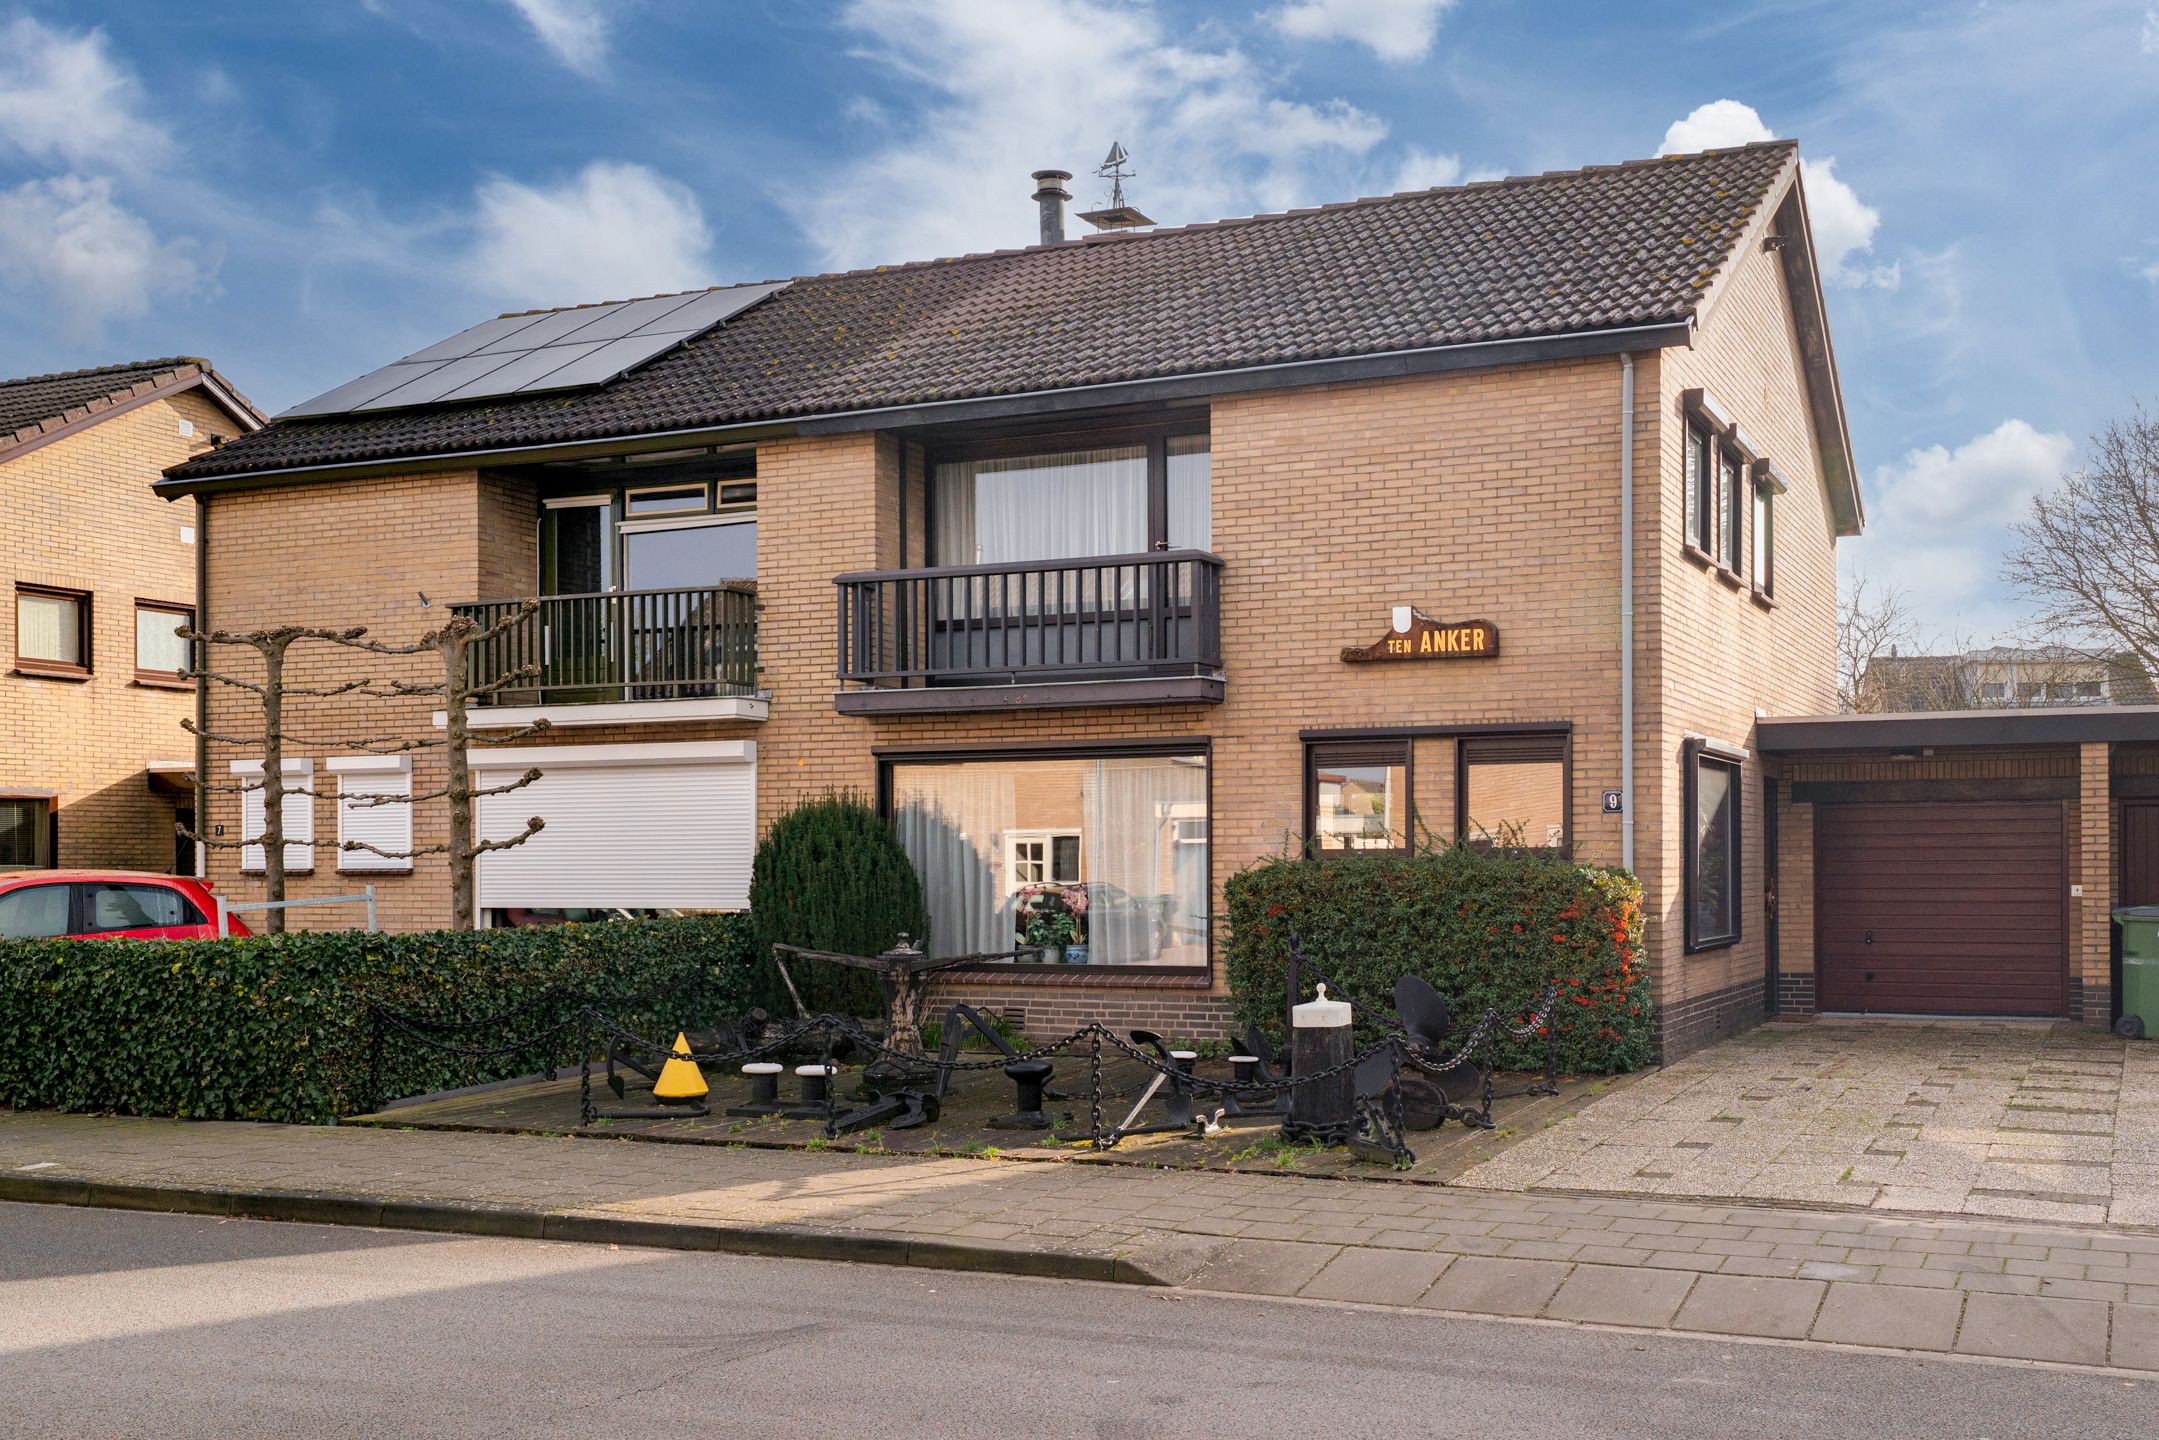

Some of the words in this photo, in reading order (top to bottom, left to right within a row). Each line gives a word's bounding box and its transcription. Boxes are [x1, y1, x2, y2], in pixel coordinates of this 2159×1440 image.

[1388, 640, 1411, 653] TEN
[1420, 628, 1485, 653] ANKER
[1609, 794, 1617, 809] 9
